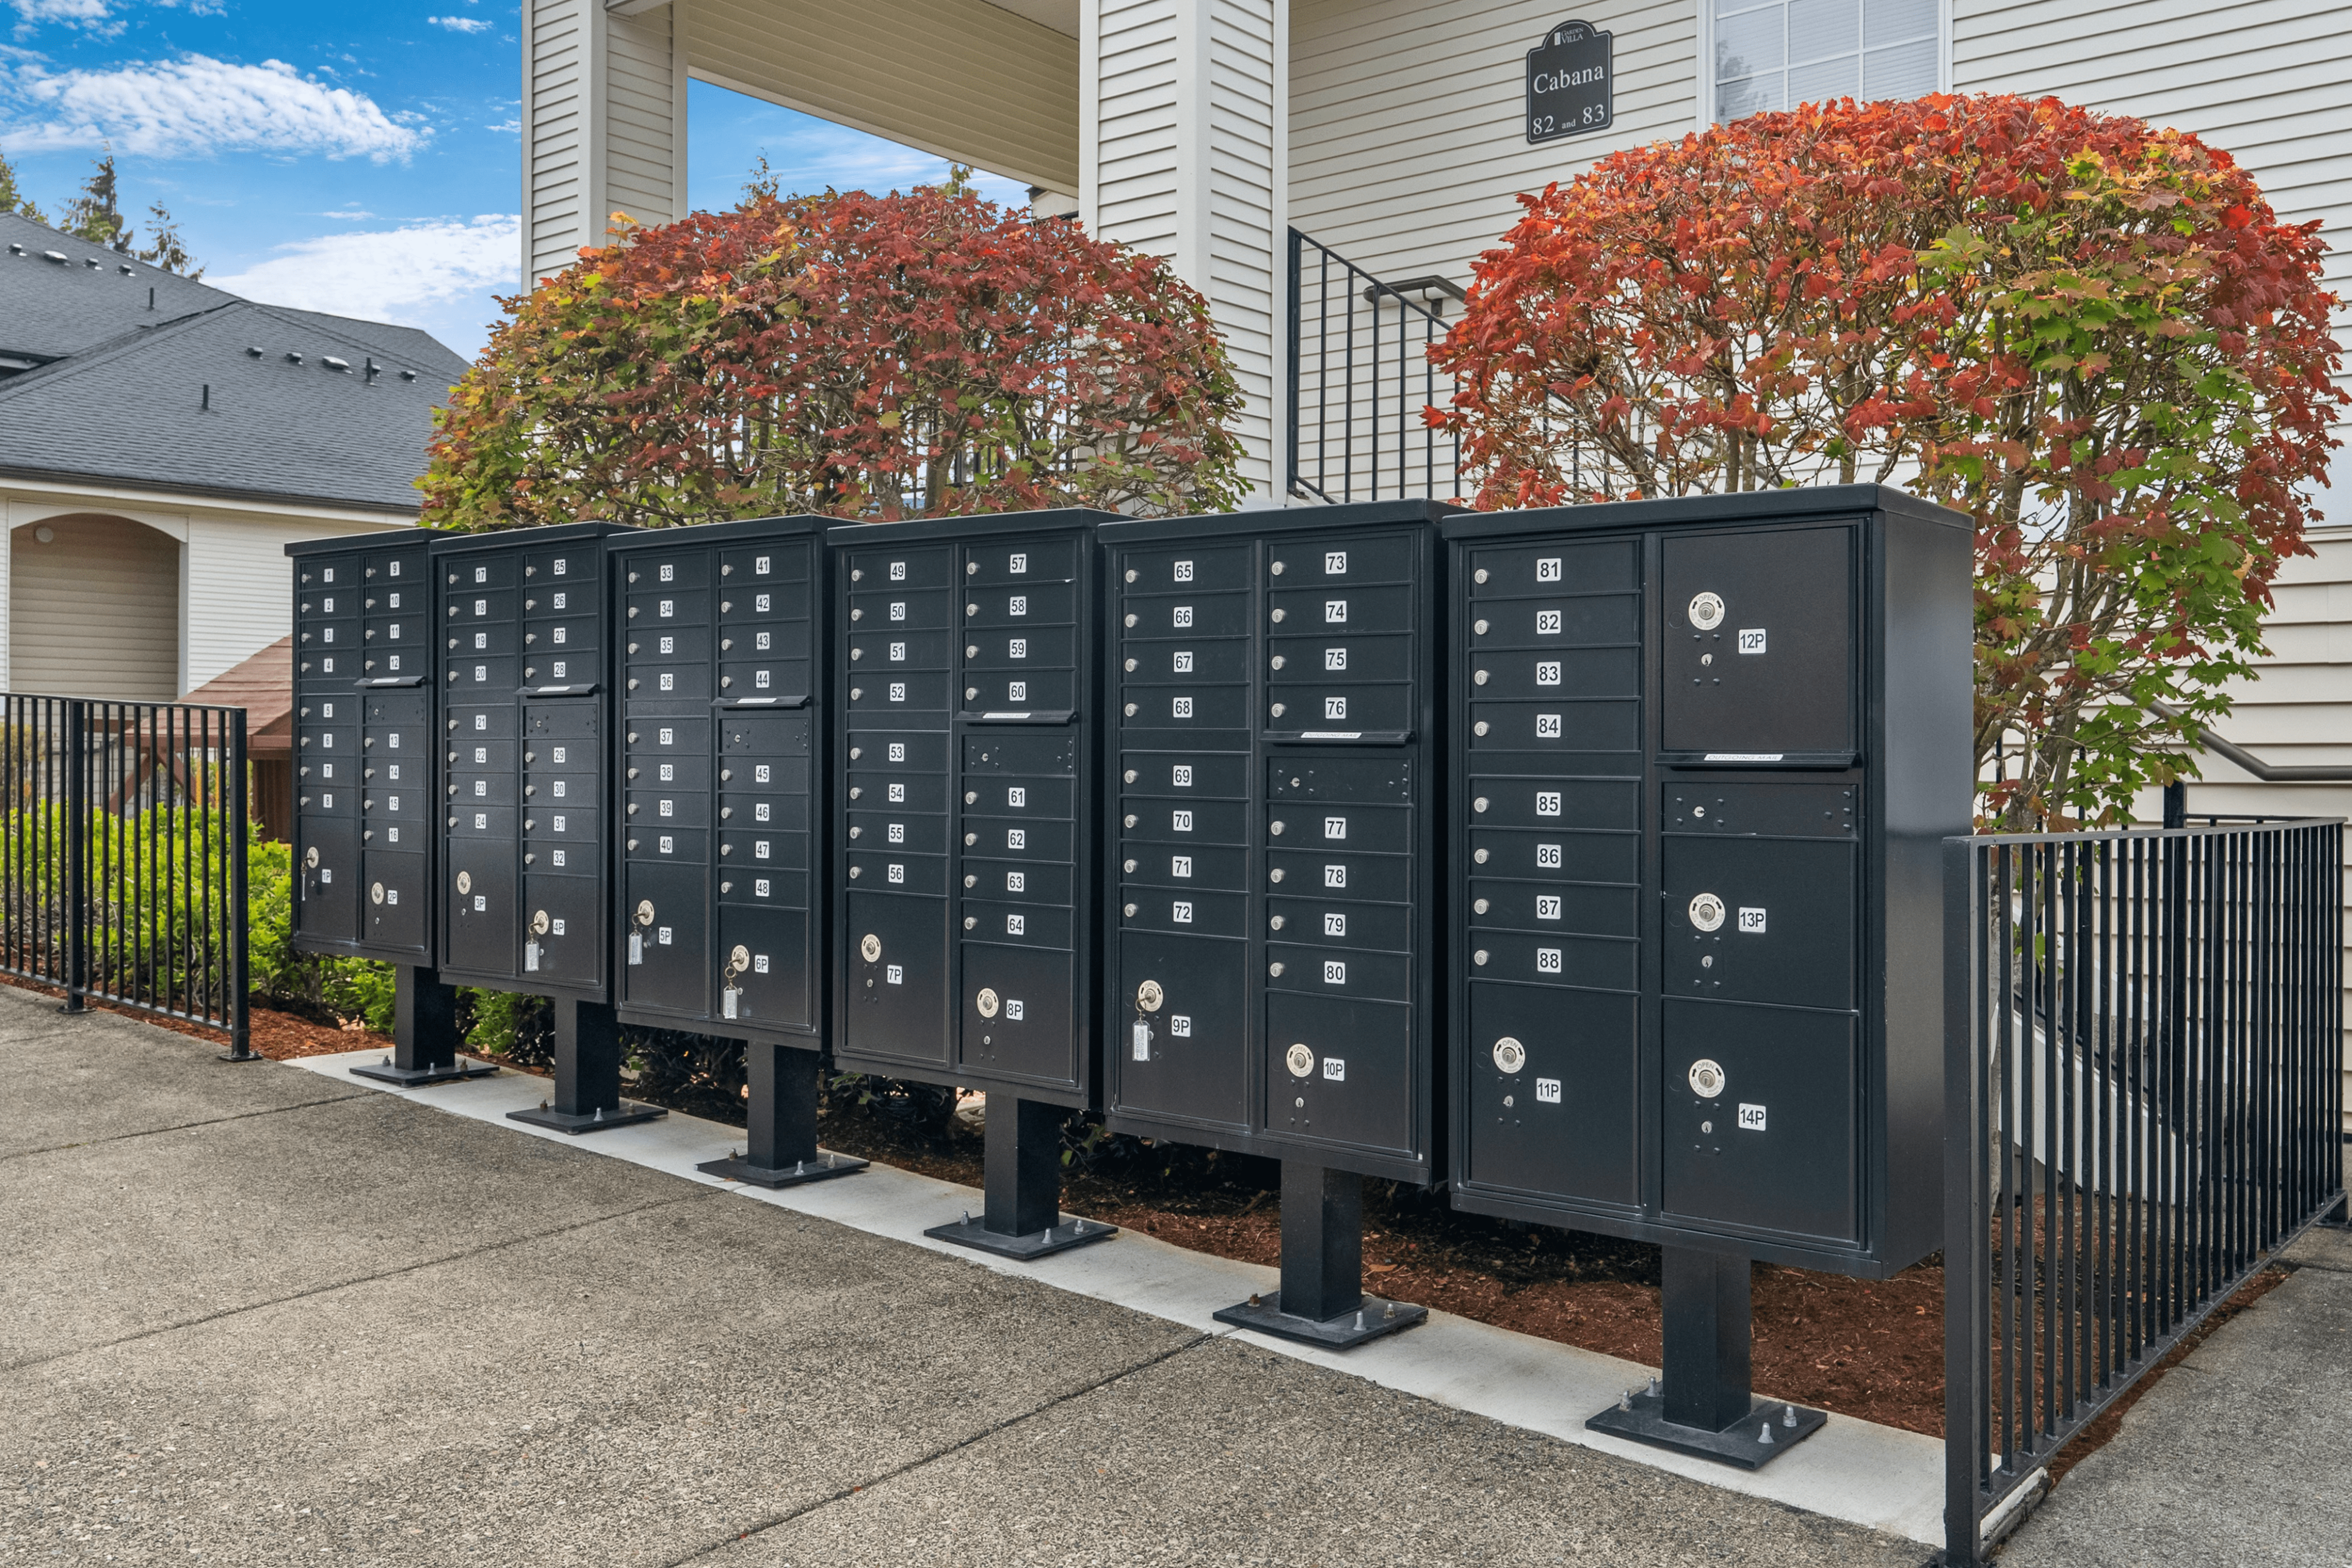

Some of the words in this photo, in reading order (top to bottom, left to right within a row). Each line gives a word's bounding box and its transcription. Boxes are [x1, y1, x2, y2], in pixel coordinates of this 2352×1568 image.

[1561, 33, 1583, 44] VILLA
[1533, 65, 1604, 94] Cabana
[1533, 115, 1554, 135] 82
[1561, 118, 1576, 129] and
[1583, 104, 1605, 124] 83
[556, 562, 564, 572] 25
[758, 560, 768, 571] 41
[1012, 557, 1024, 570] 57
[1328, 555, 1344, 570] 73
[477, 570, 485, 580] 17
[662, 567, 671, 579] 33
[892, 565, 904, 577] 49
[1177, 564, 1191, 578] 65
[1540, 562, 1557, 578] 81
[392, 596, 398, 605] 10
[555, 596, 564, 606] 26
[757, 598, 768, 609] 42
[1012, 599, 1024, 612] 58
[477, 602, 485, 613] 18
[662, 603, 671, 614] 34
[892, 606, 903, 618] 50
[1328, 605, 1344, 618] 74
[1175, 610, 1190, 624] 66
[1539, 614, 1558, 630] 82
[392, 627, 398, 636] 11
[555, 630, 564, 641] 27
[477, 636, 485, 646] 19
[662, 640, 671, 651] 35
[758, 635, 768, 646] 43
[1740, 633, 1764, 649] 12P
[892, 646, 903, 657] 51
[1012, 642, 1024, 655] 59
[392, 658, 398, 667] 12
[1176, 656, 1191, 669] 67
[1328, 652, 1344, 666] 75
[477, 668, 485, 679] 20
[555, 664, 564, 675] 28
[1539, 666, 1558, 681] 83
[662, 676, 671, 687] 36
[757, 673, 768, 685] 44
[892, 686, 903, 698] 52
[1011, 685, 1024, 698] 60
[1175, 700, 1190, 714] 68
[1328, 701, 1344, 715] 76
[478, 718, 485, 727] 21
[1539, 718, 1558, 733] 84
[390, 736, 397, 745] 13
[662, 731, 671, 742] 37
[477, 750, 485, 760] 22
[555, 750, 564, 760] 29
[891, 746, 902, 758] 53
[391, 768, 397, 776] 14
[662, 767, 671, 777] 38
[757, 768, 768, 779] 45
[1175, 769, 1190, 783] 69
[477, 784, 485, 793] 23
[555, 784, 563, 794] 30
[891, 787, 902, 799] 54
[1011, 791, 1023, 803] 61
[390, 799, 397, 808] 15
[662, 802, 671, 813] 39
[1539, 796, 1558, 812] 85
[757, 807, 768, 818] 46
[477, 816, 485, 826] 24
[556, 818, 563, 828] 31
[1175, 814, 1190, 827] 70
[891, 827, 902, 839] 55
[1327, 820, 1344, 835] 77
[390, 830, 397, 839] 16
[1010, 833, 1023, 846] 62
[662, 839, 671, 850] 40
[757, 845, 768, 855] 47
[555, 853, 563, 864] 32
[1539, 848, 1558, 864] 86
[1175, 860, 1189, 874] 71
[323, 872, 330, 880] 1P
[890, 867, 902, 880] 56
[1327, 869, 1344, 884] 78
[757, 882, 768, 894] 48
[1009, 876, 1022, 889] 63
[389, 893, 397, 902] 2P
[476, 898, 484, 908] 3P
[1175, 905, 1190, 919] 72
[1539, 900, 1558, 915] 87
[1009, 919, 1022, 932] 64
[1327, 917, 1343, 932] 79
[1740, 912, 1764, 927] 13P
[554, 923, 563, 932] 4P
[660, 930, 670, 941] 5P
[756, 958, 767, 970] 6P
[1539, 953, 1558, 969] 88
[889, 969, 901, 981] 7P
[1326, 965, 1343, 980] 80
[1008, 1003, 1022, 1016] 8P
[1173, 1019, 1189, 1033] 9P
[1502, 1040, 1518, 1048] OPEN
[1325, 1062, 1343, 1076] 10P
[1538, 1082, 1559, 1097] 11P
[1740, 1109, 1764, 1125] 14P
